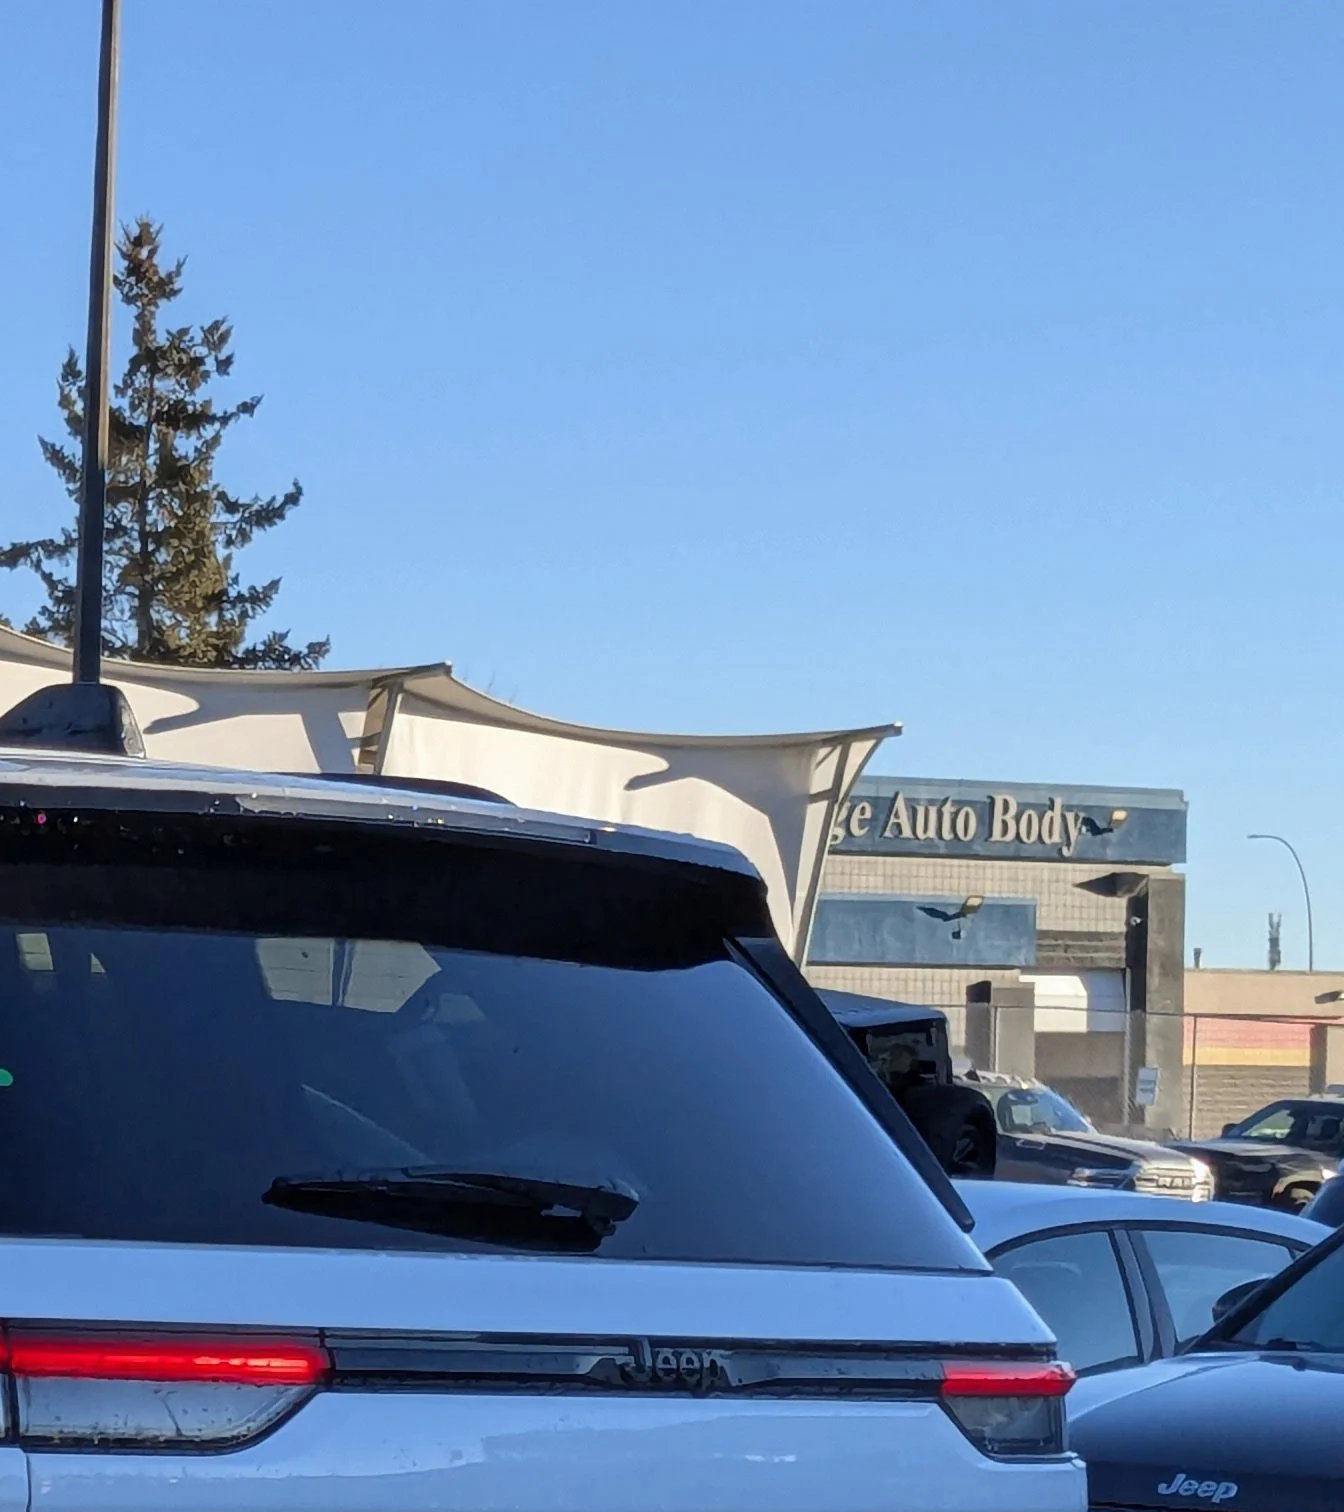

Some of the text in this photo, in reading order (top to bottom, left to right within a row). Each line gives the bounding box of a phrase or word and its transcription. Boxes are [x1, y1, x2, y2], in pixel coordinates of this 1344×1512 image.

[884, 790, 977, 842] Auto
[989, 794, 1084, 858] Body
[620, 1337, 720, 1390] Jeep
[1157, 1472, 1239, 1504] Jeep
